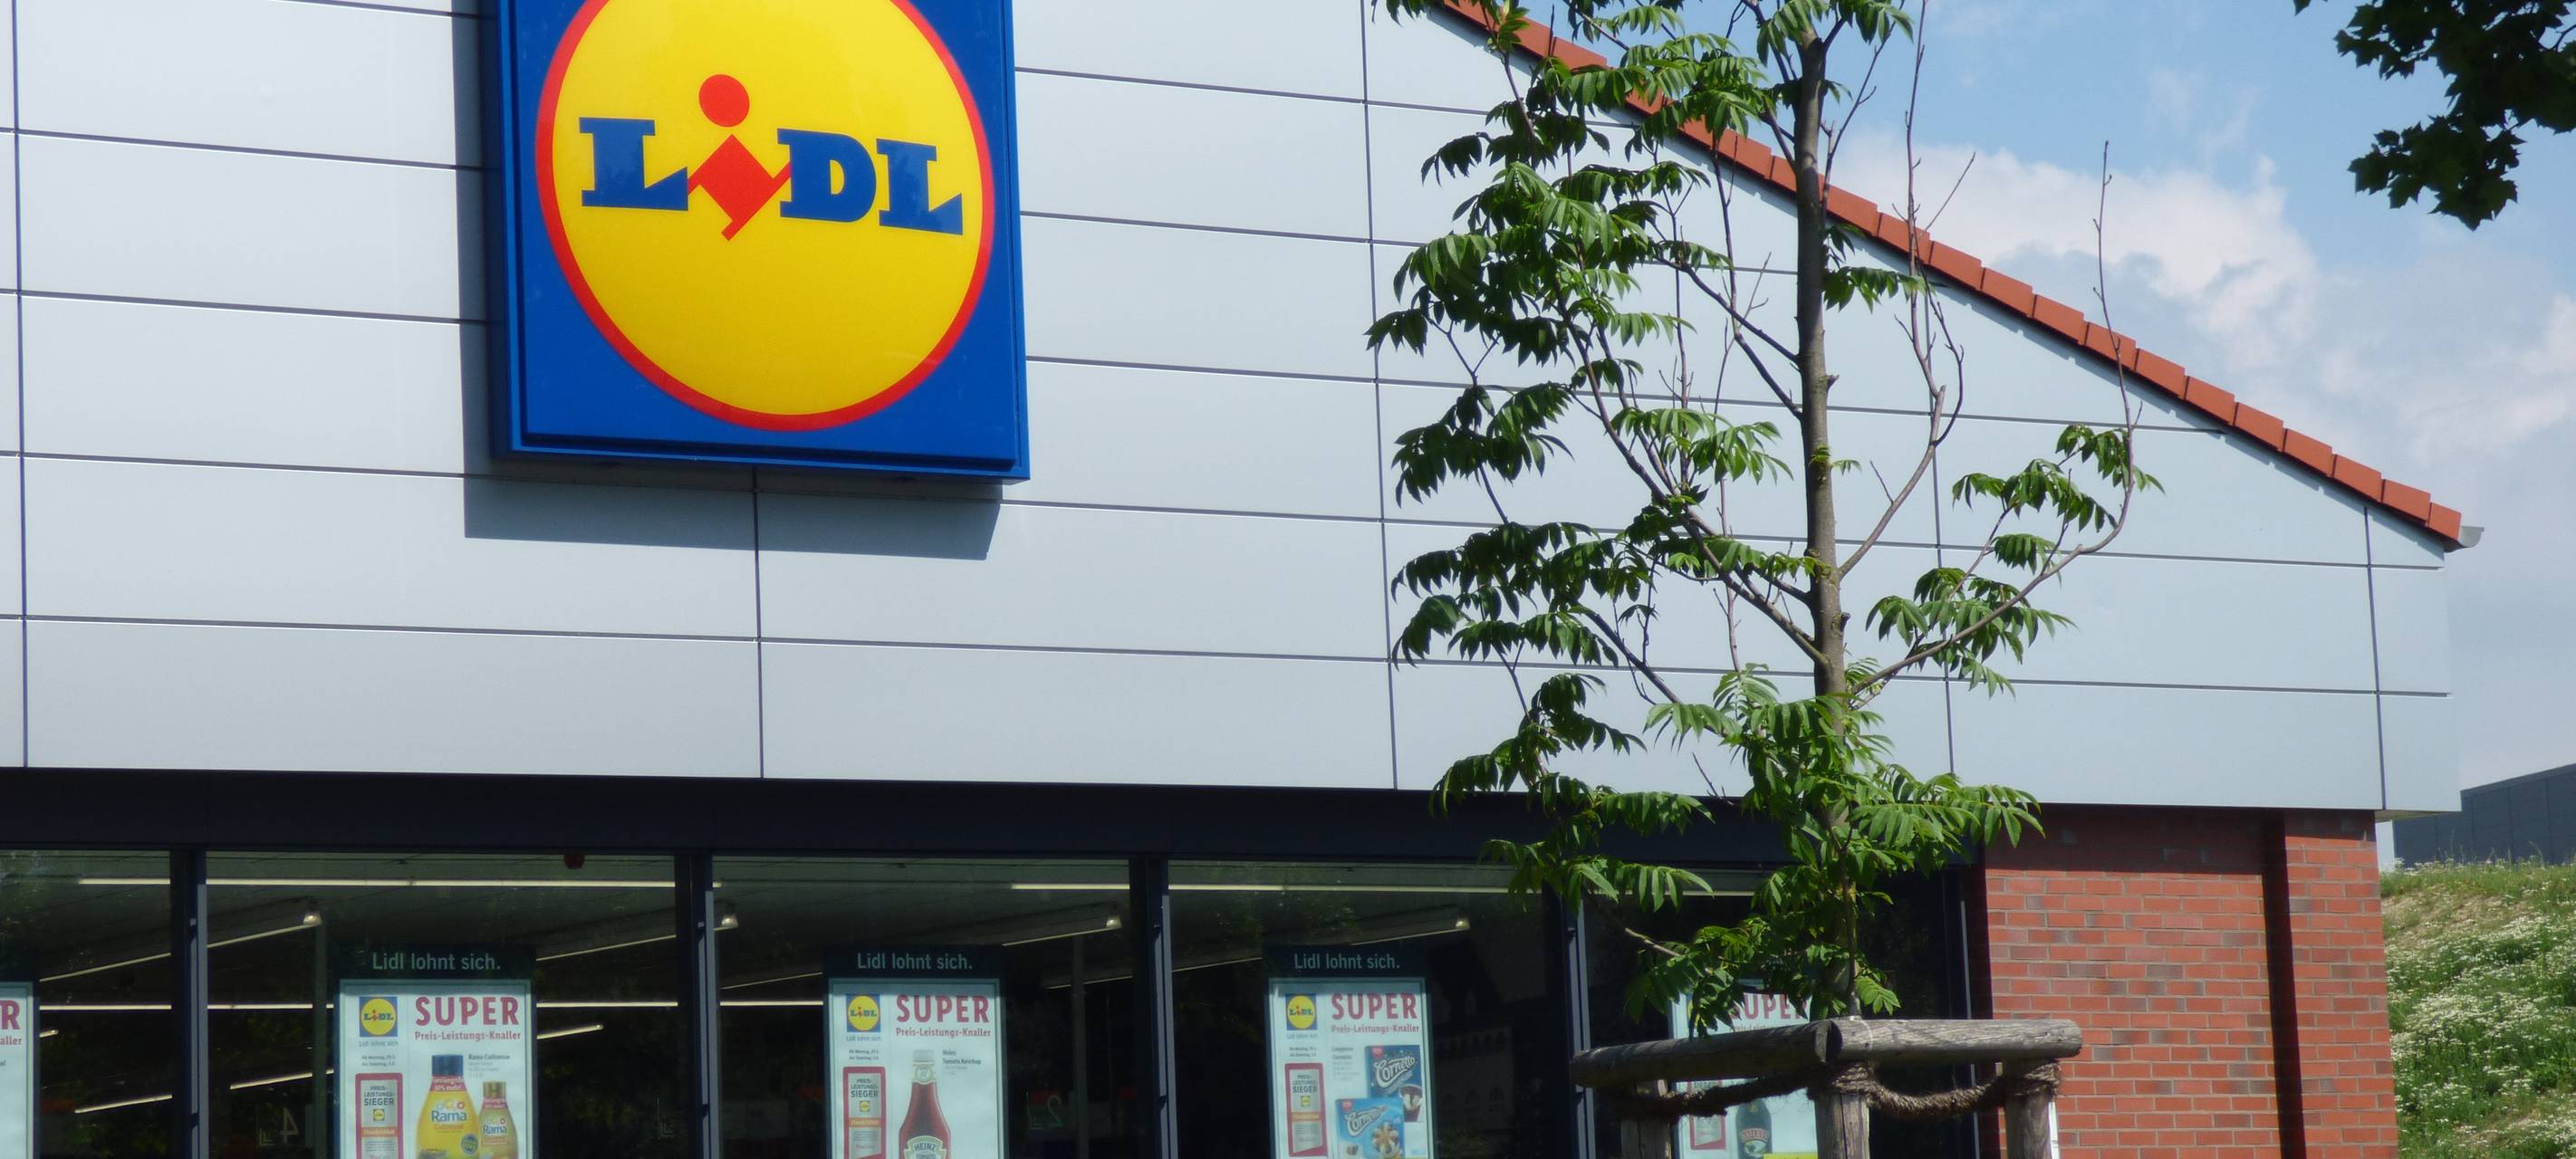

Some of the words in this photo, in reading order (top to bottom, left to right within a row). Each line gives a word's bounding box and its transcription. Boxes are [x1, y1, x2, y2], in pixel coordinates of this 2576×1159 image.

[372, 953, 405, 970] Lidl
[411, 953, 455, 970] lohnt
[461, 953, 501, 970] sich.
[857, 953, 886, 970] Lidl
[892, 953, 932, 970] lohnt
[937, 953, 973, 970] sich.
[1294, 953, 1321, 969] Lidl
[1326, 953, 1362, 969] lohnt
[1368, 953, 1400, 969] sich.
[415, 997, 520, 1026] SUPER
[897, 994, 990, 1023] SUPER
[1331, 992, 1418, 1020] SUPER
[415, 1030, 521, 1041] Preis-Leistungs-Knaller
[896, 1028, 991, 1039] Preis-Leistungs-Knaller
[1331, 1024, 1420, 1035] Preis-Leistungs-Knaller
[1373, 1055, 1418, 1087] Cornetto
[851, 1089, 879, 1098] SIEGER
[431, 1110, 466, 1123] Rama
[1345, 1106, 1388, 1137] Cornetto
[483, 1125, 507, 1135] Rama
[914, 1143, 937, 1152] HEINZ
